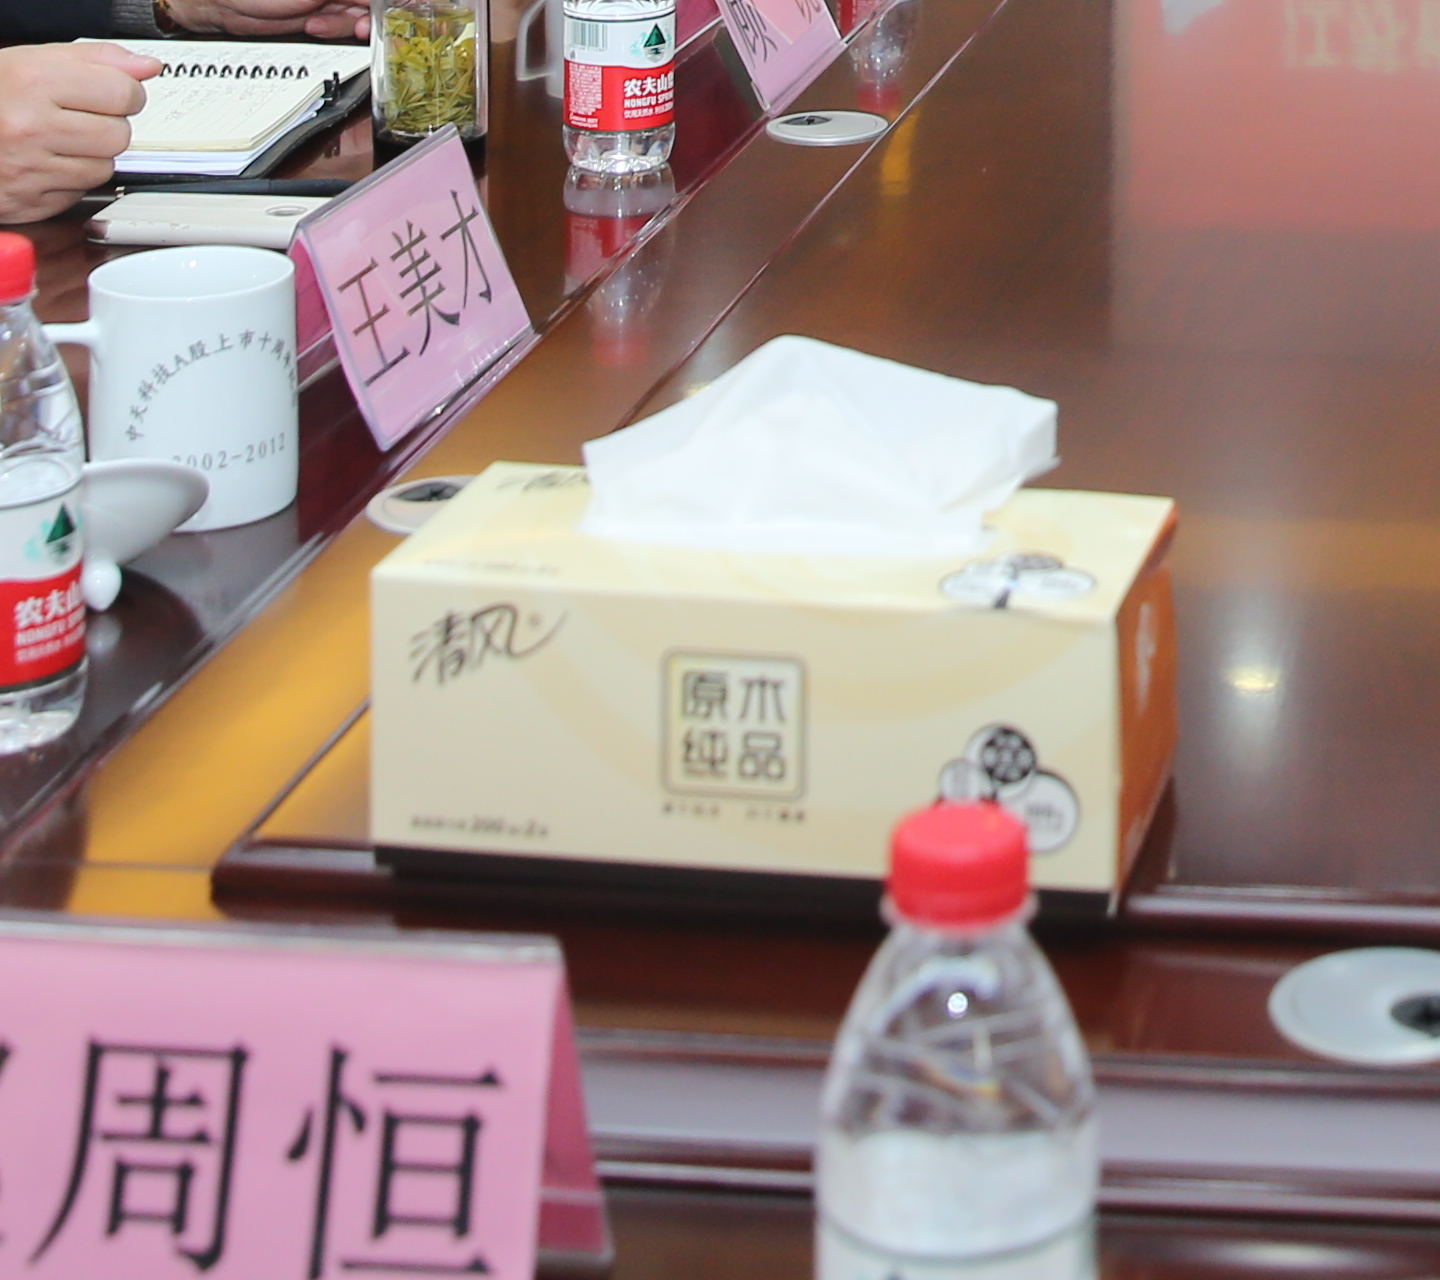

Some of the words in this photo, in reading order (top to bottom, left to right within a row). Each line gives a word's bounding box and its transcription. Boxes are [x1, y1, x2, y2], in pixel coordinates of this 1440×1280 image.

[337, 190, 495, 389] 王美才
[409, 604, 569, 685] 清风
[682, 670, 786, 724] 原木
[682, 728, 786, 780] 纯品
